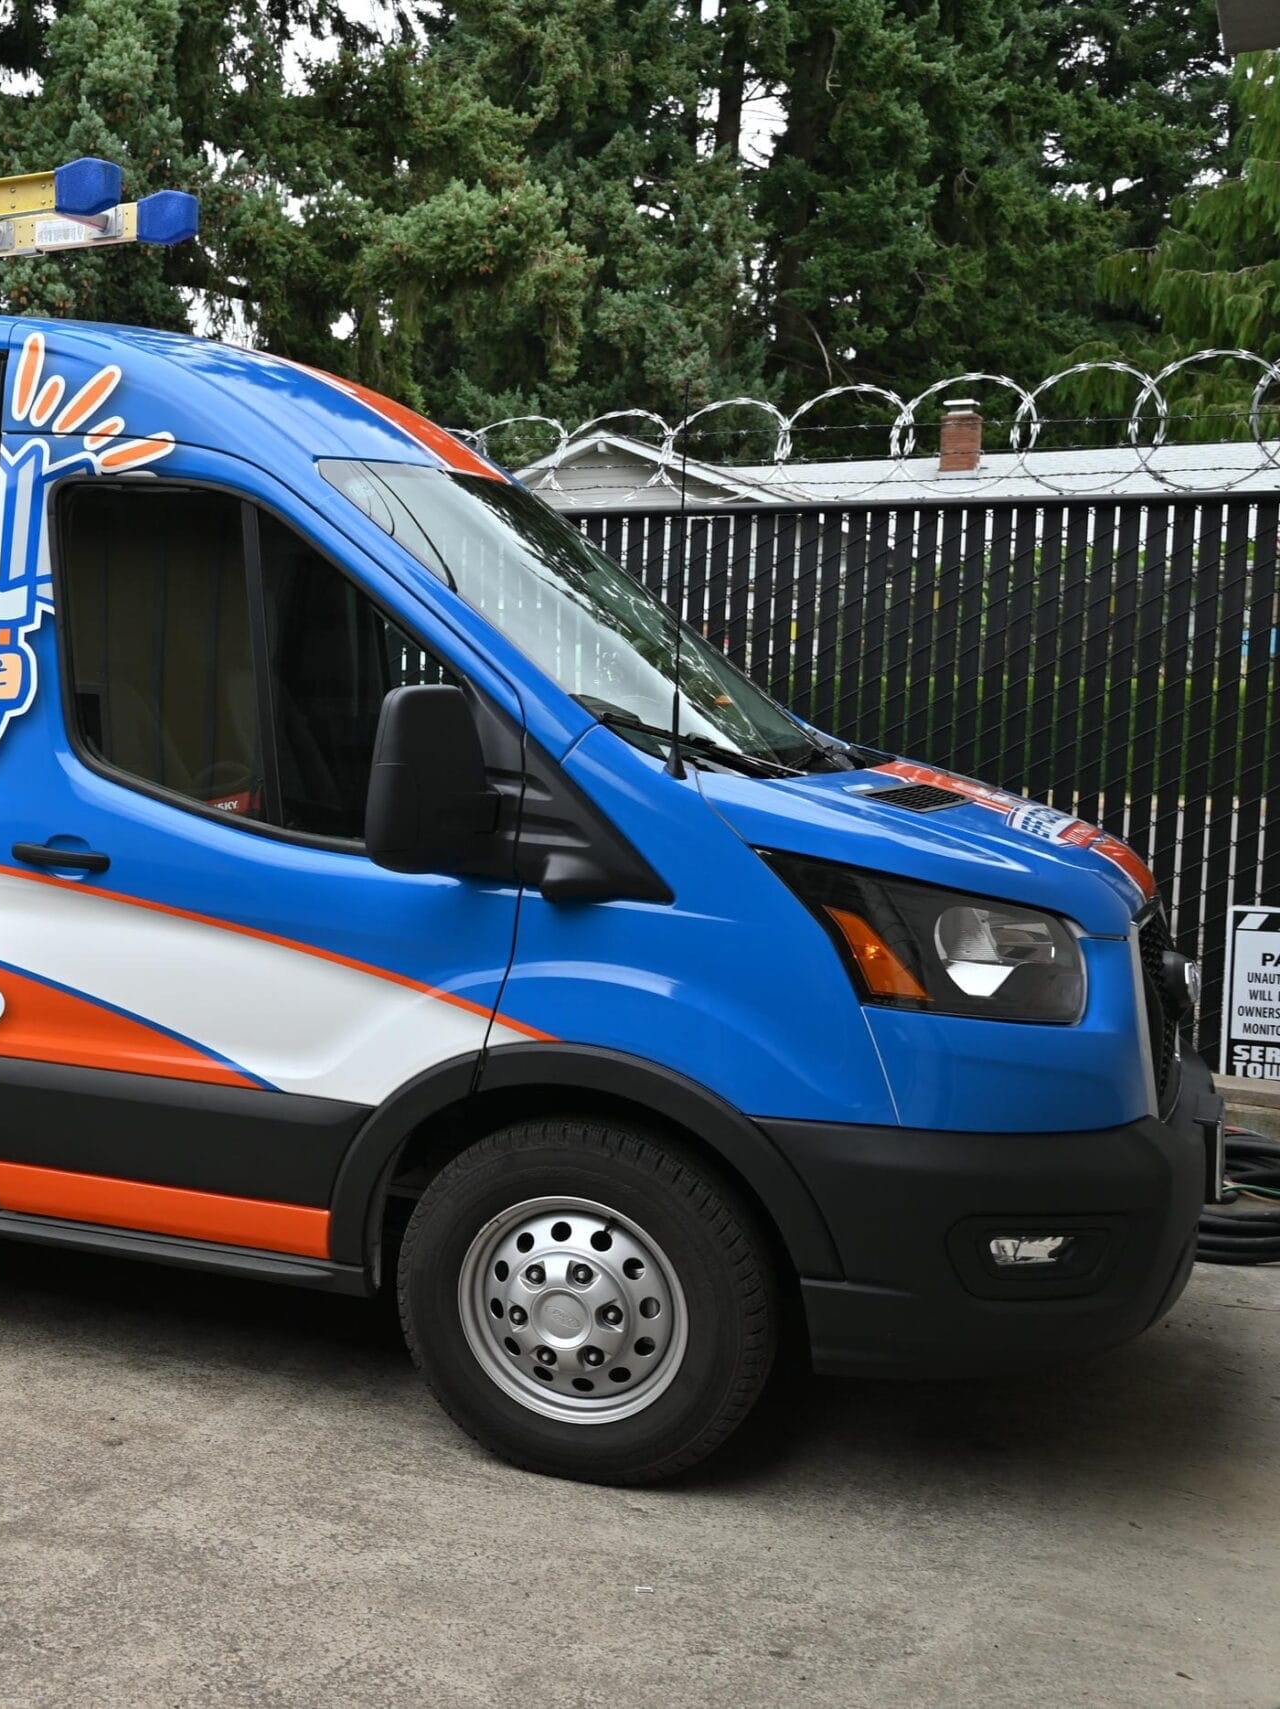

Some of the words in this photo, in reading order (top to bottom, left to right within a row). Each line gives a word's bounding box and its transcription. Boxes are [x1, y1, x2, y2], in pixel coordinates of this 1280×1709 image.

[1249, 989, 1273, 1001] WILL
[1237, 1005, 1280, 1019] OWNERS
[1233, 1044, 1280, 1064] SER
